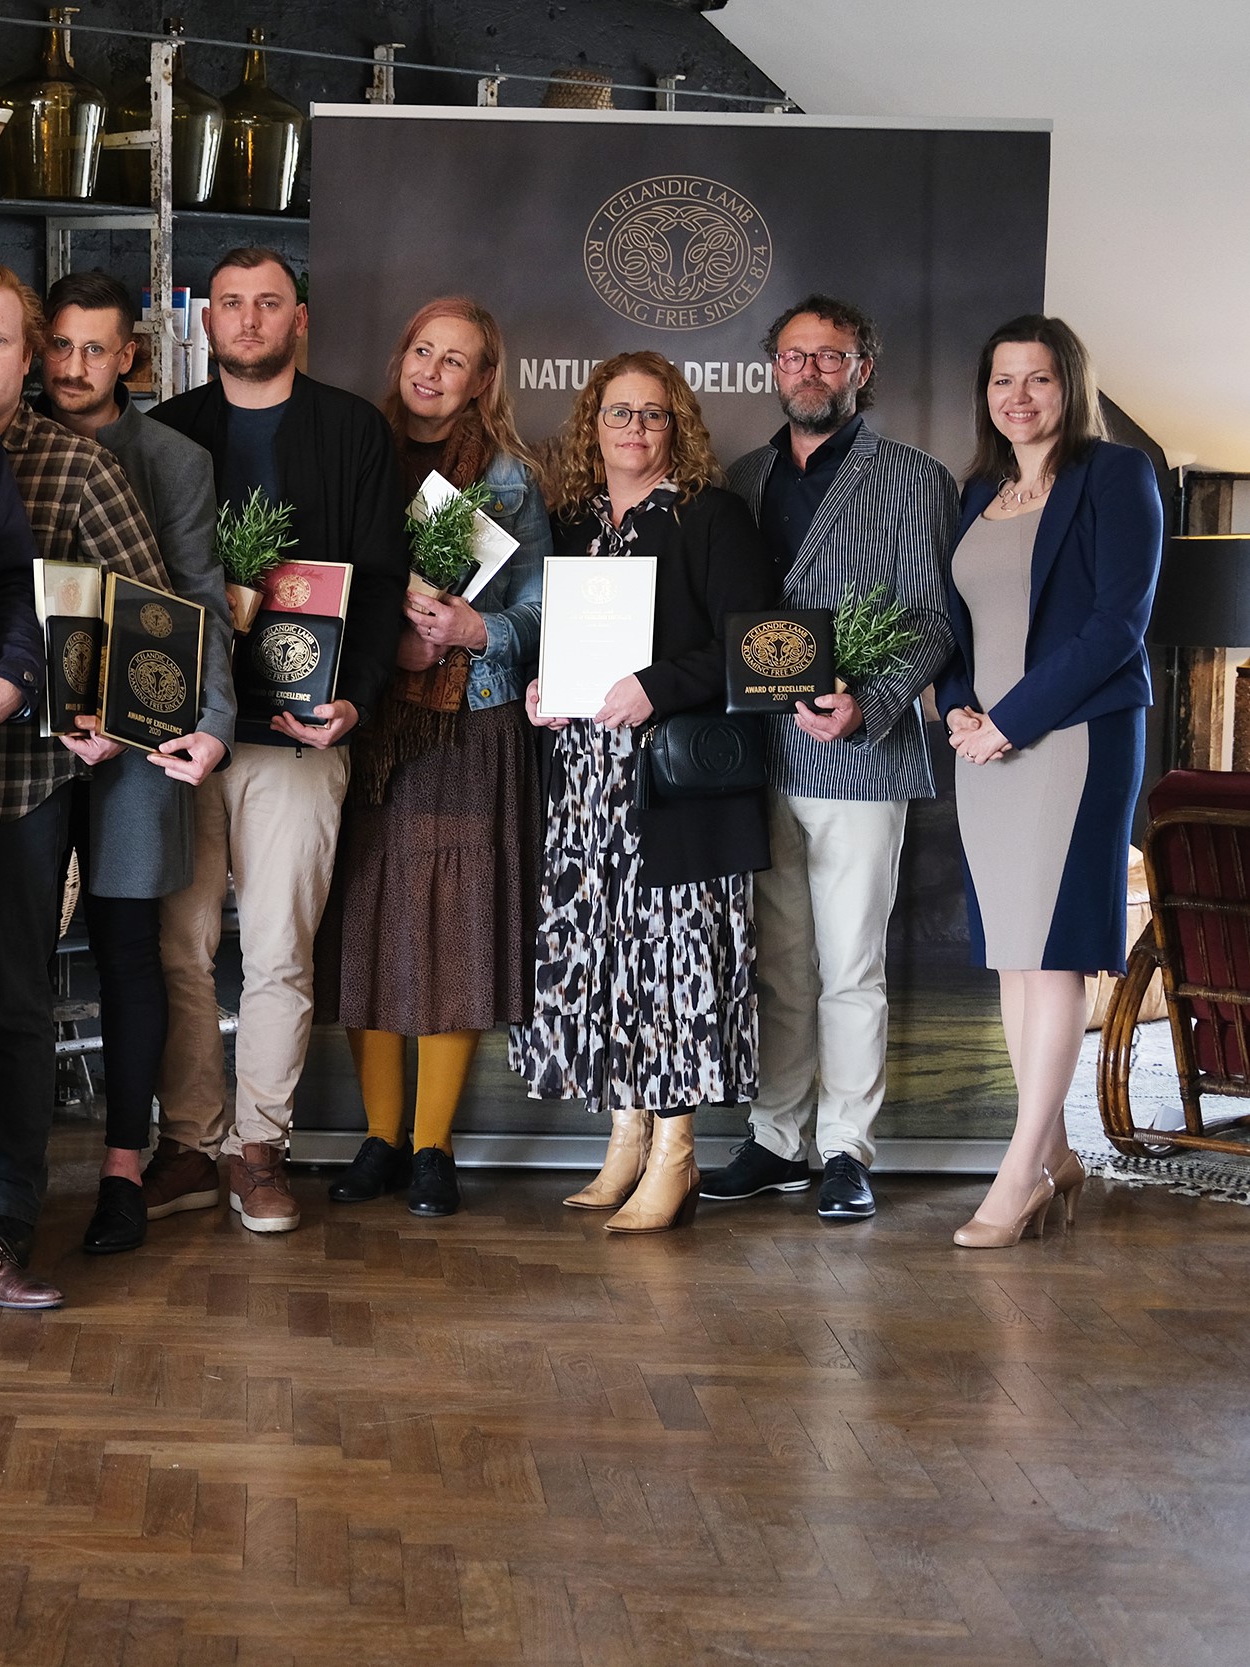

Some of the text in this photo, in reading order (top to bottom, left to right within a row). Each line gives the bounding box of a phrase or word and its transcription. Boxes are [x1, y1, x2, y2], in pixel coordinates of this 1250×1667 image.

[603, 180, 754, 225] ICELANDIC LAMB
[588, 240, 769, 327] ROAMING FREE SINCE 874
[519, 358, 779, 393] NATU DELICI
[748, 623, 808, 640] ICELANDIC LAMB
[276, 690, 312, 702] EXCELLENCE
[745, 686, 767, 694] AWARD
[777, 685, 815, 693] EXCELLENCE
[772, 693, 788, 701] 2020
